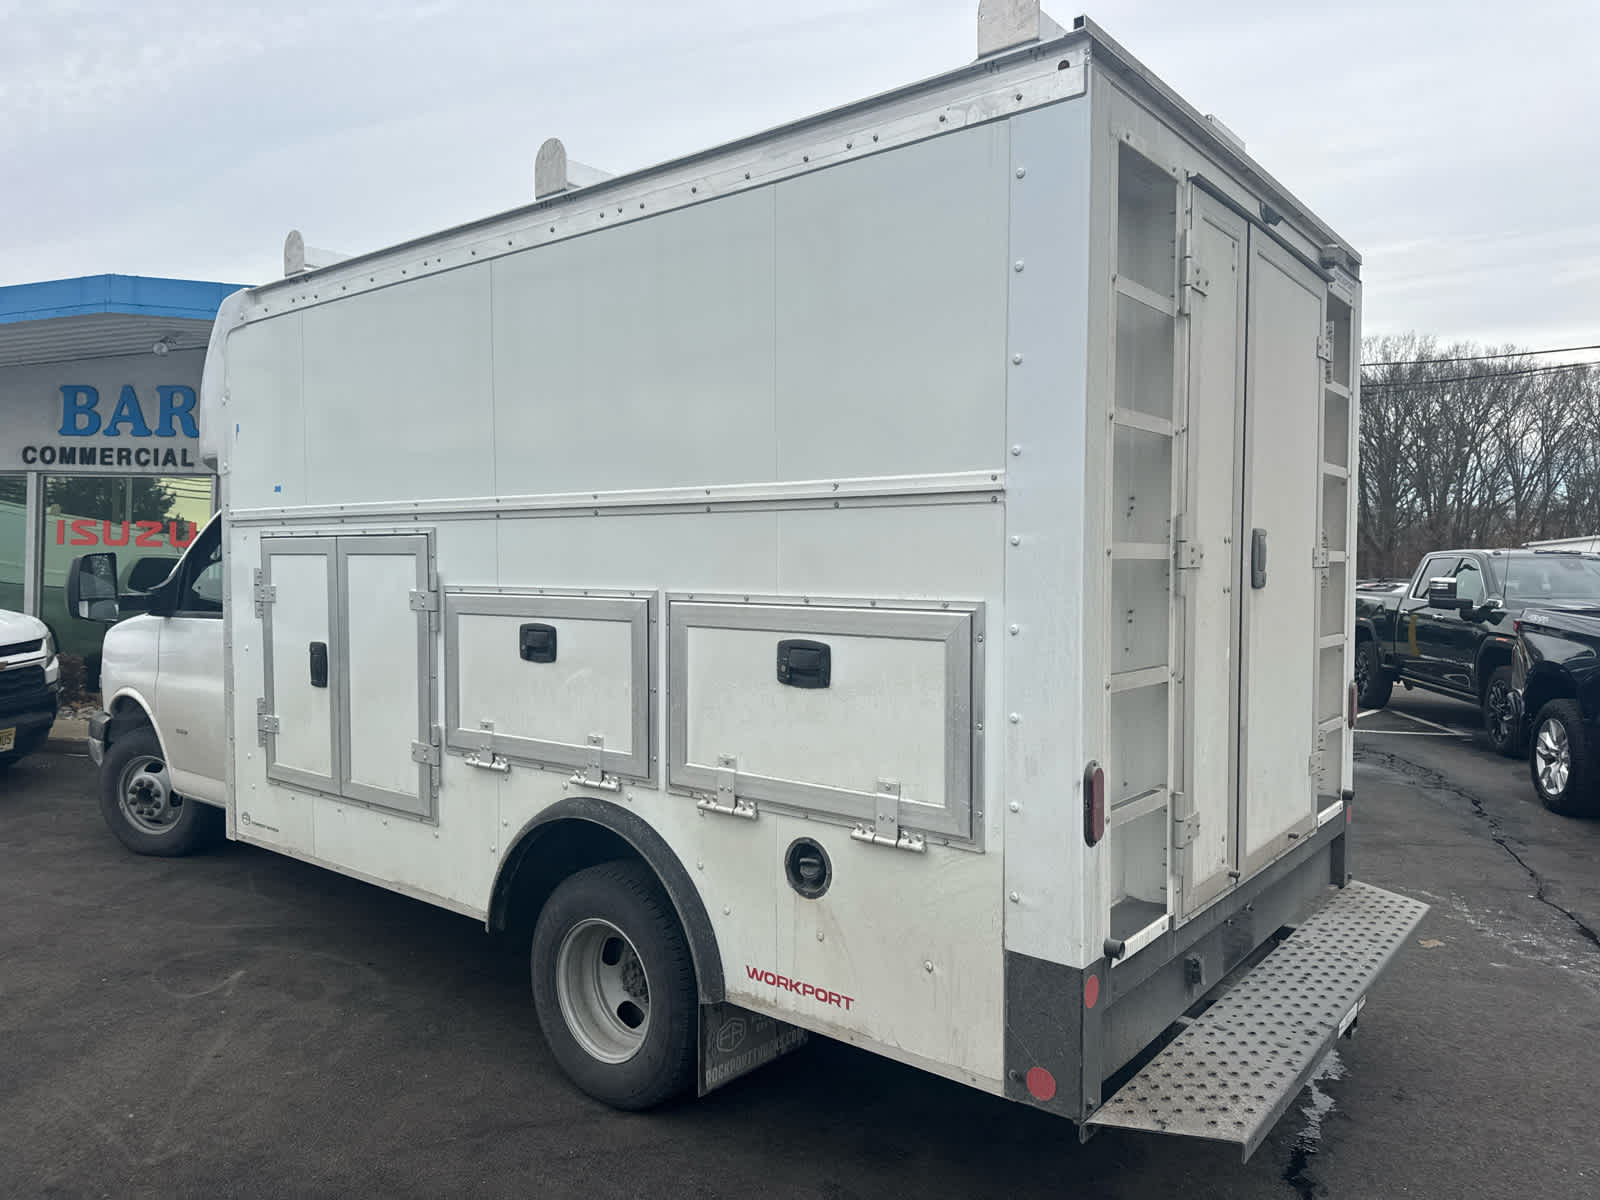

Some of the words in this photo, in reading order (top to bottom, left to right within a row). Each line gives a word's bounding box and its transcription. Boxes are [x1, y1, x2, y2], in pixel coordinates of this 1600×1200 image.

[57, 384, 200, 438] BAR
[22, 446, 195, 467] COMMERCIAL
[56, 519, 197, 548] ISUZU
[745, 965, 855, 1010] WORKPORT
